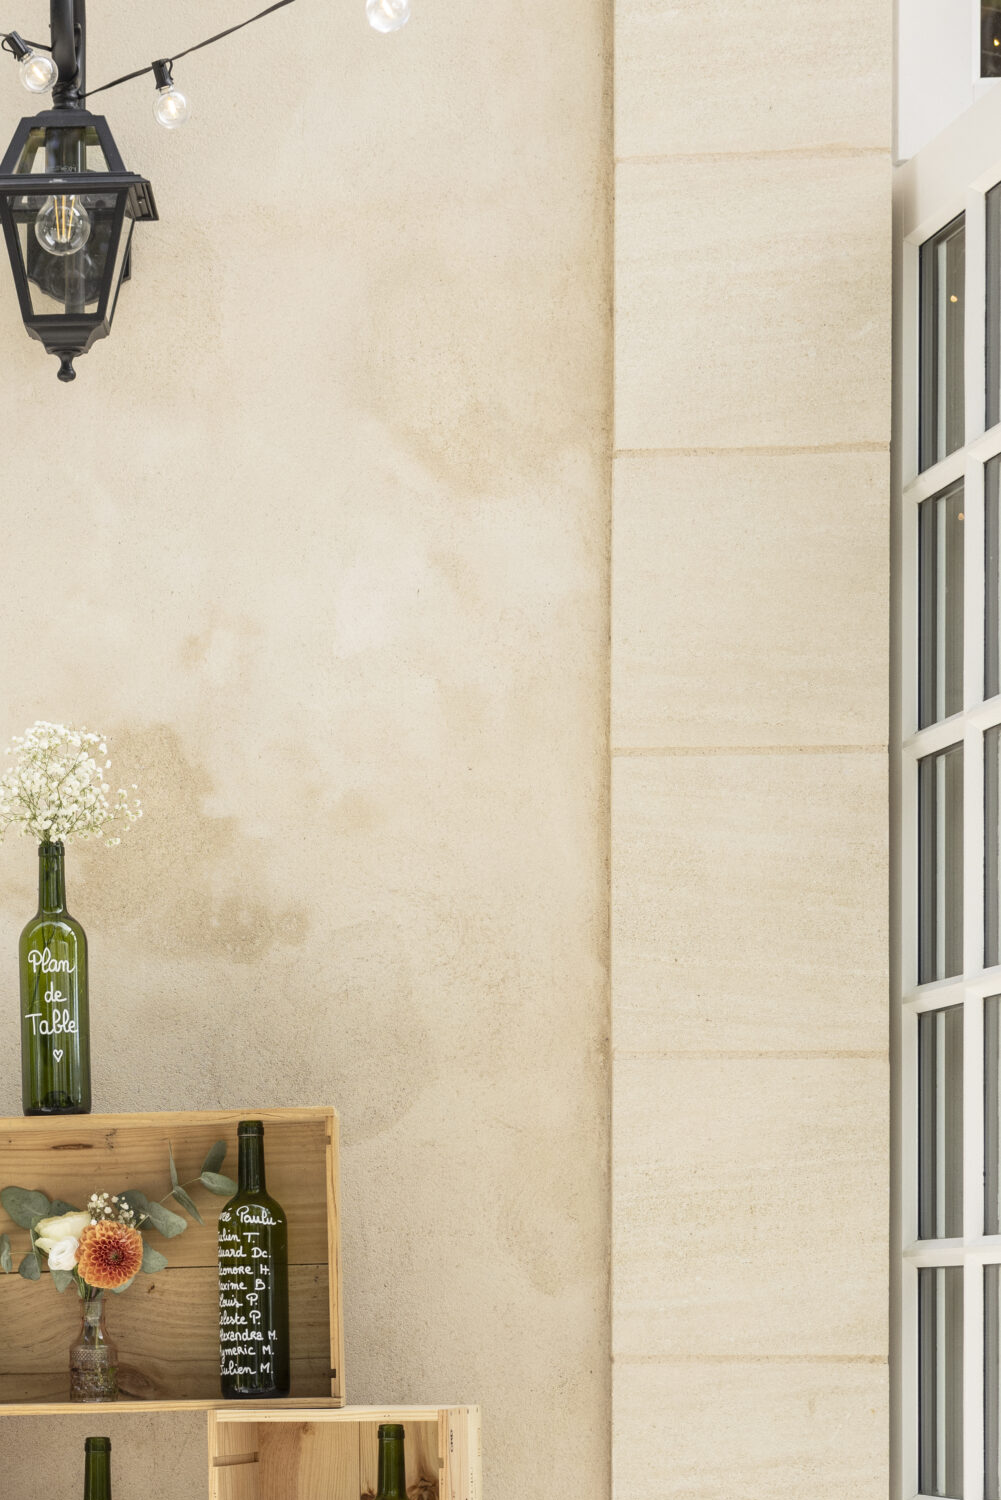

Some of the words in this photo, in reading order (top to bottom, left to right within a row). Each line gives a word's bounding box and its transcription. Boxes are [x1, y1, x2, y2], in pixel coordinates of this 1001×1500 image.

[28, 947, 76, 973] Plan
[44, 981, 67, 1003] de
[25, 1009, 78, 1035] Table
[243, 1233, 259, 1243] T.
[251, 1247, 271, 1258] Dc.
[260, 1264, 271, 1275] H.
[255, 1279, 271, 1290] B.
[246, 1293, 258, 1306] P.
[249, 1310, 261, 1324] P.
[268, 1330, 277, 1340] M.
[262, 1345, 274, 1355] M.
[261, 1362, 273, 1374] M.
